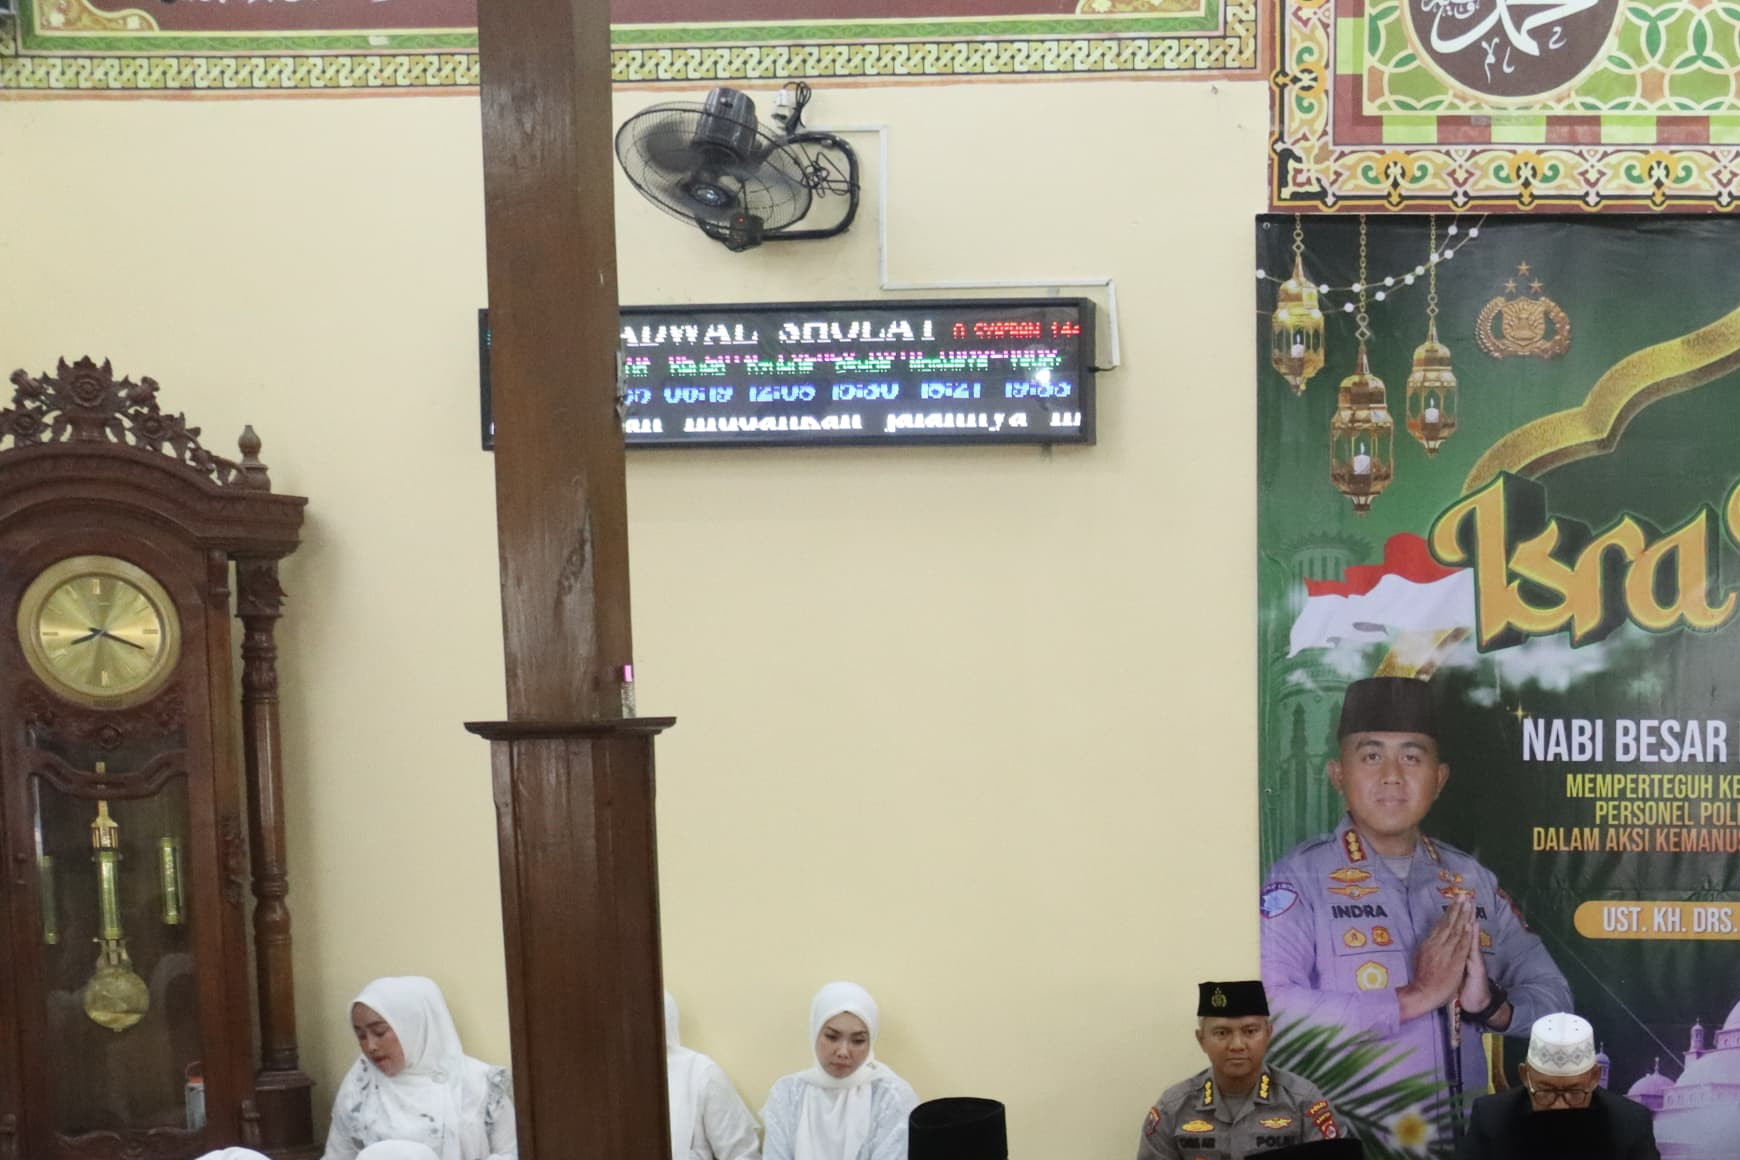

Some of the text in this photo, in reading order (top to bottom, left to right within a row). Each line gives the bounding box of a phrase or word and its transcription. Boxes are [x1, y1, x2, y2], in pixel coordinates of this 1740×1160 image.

[1433, 472, 1738, 648] Isra
[1522, 718, 1604, 761] NABI
[1615, 719, 1727, 763] BESAR
[1566, 774, 1713, 799] MEMPERTEGUH
[1595, 801, 1694, 826] PERSONEL
[1532, 827, 1599, 852] DALAM
[1605, 828, 1649, 852] AKSI
[1331, 904, 1388, 919] INDRA
[1603, 907, 1647, 932] UST.
[1653, 907, 1687, 933] KH.
[1693, 908, 1738, 933] DRS.
